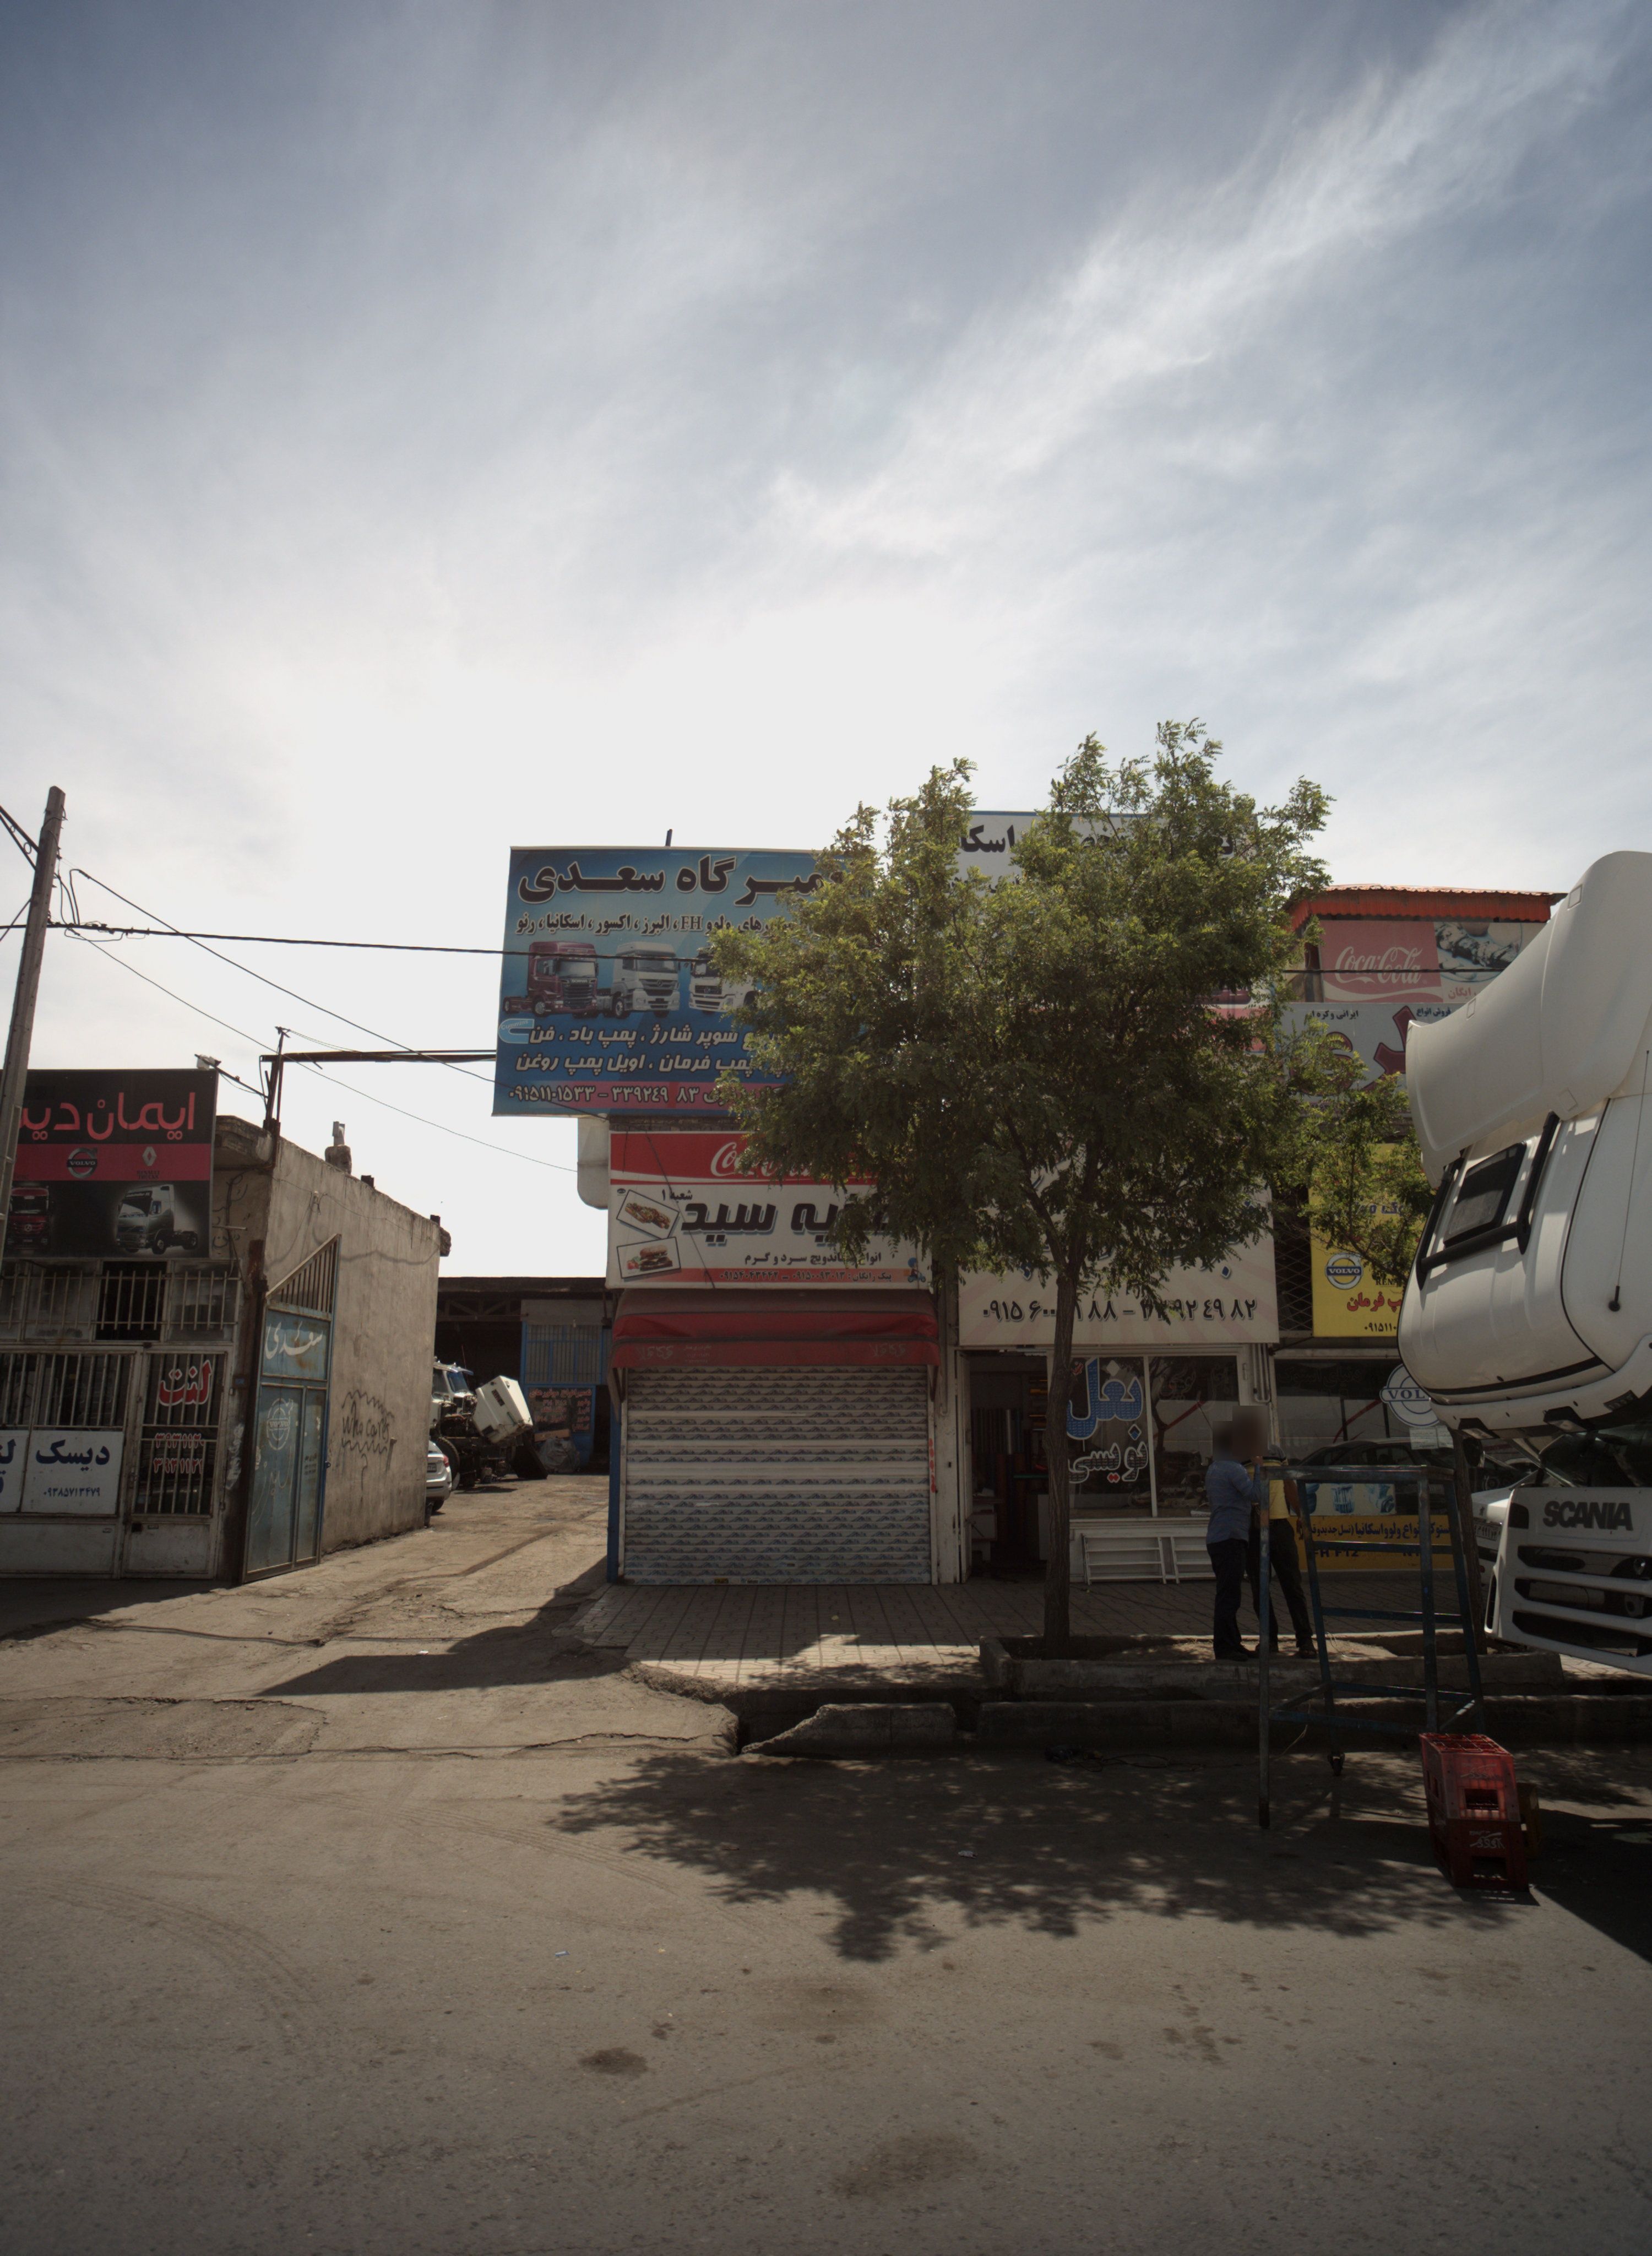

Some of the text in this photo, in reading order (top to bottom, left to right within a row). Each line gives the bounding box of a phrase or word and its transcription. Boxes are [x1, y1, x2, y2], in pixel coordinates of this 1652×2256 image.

[518, 861, 664, 904] سعدی
[516, 915, 535, 934] رنو
[546, 914, 585, 933] اسکانیا
[594, 914, 631, 935] اکسور
[681, 915, 703, 930] FH
[1335, 946, 1423, 984] Coca-Cola
[1448, 986, 1476, 1000] ایگان
[1336, 1010, 1358, 1019] ایرانی
[1416, 1007, 1452, 1017] فروش انواع
[530, 1026, 555, 1044] فن
[569, 1027, 594, 1046] باد
[598, 1031, 637, 1048] پمپ
[650, 1024, 692, 1045] شارژ
[695, 1031, 738, 1049] سوپر
[517, 1051, 558, 1071] روغن
[564, 1056, 604, 1076] پمپ
[602, 1053, 645, 1072] اویل
[659, 1054, 711, 1073] فرمان
[87, 1093, 195, 1140] ایمان
[670, 1190, 692, 1202] شعبه
[681, 1203, 776, 1243] سید
[745, 1252, 770, 1265] گرم
[773, 1256, 778, 1265] و
[781, 1254, 807, 1265] سرد
[878, 1273, 892, 1282] پیک
[1347, 1291, 1384, 1312] فرمان
[158, 1360, 212, 1406] لنت
[36, 1439, 110, 1471] دیسک
[1542, 1500, 1634, 1531] SCANIA
